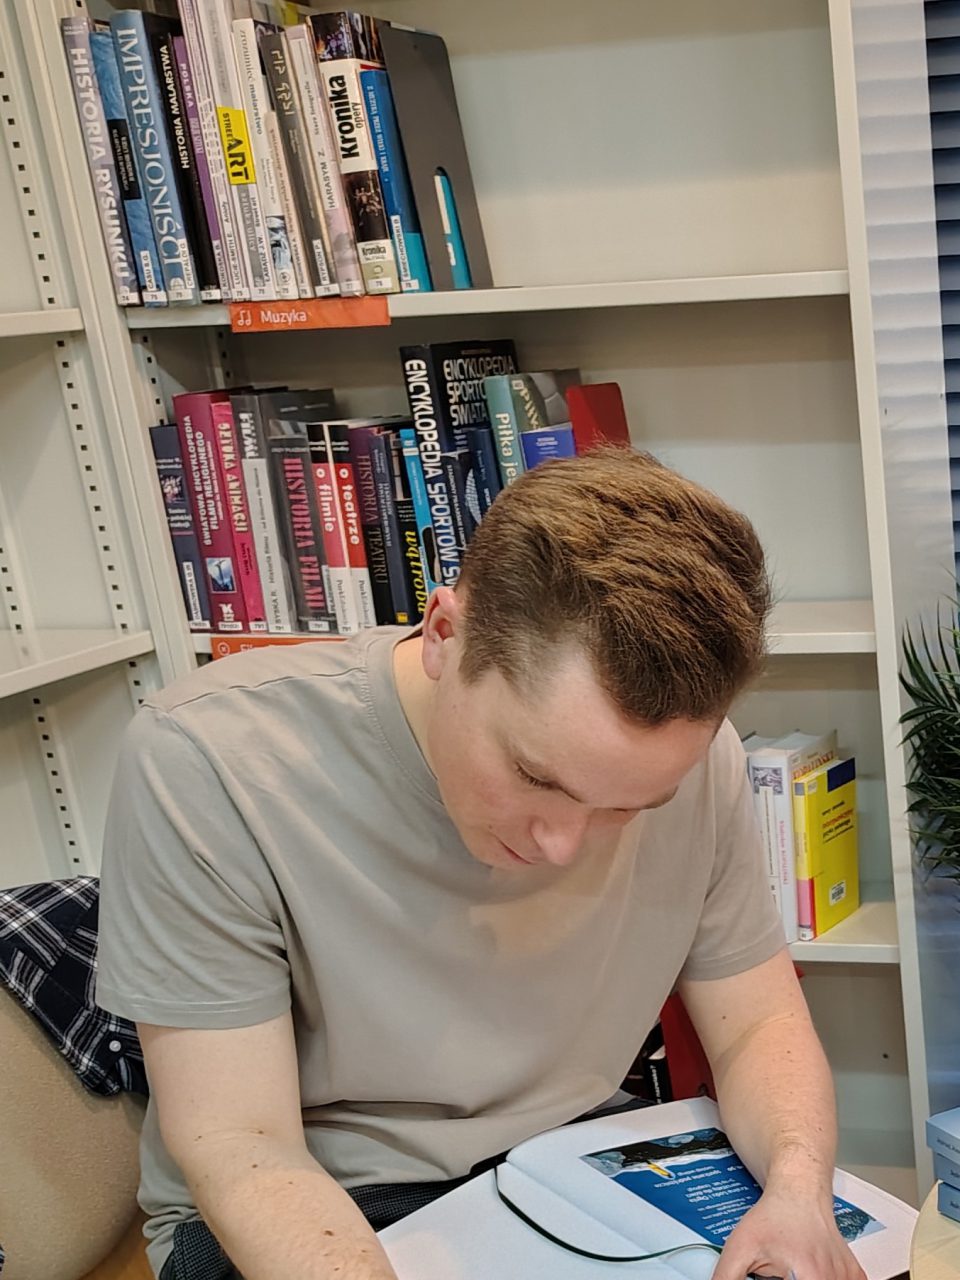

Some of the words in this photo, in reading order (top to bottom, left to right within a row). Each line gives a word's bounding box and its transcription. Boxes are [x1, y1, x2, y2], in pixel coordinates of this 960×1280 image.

[159, 45, 180, 115] MALARSTWA
[180, 63, 194, 107] POLSKA
[222, 113, 234, 142] STREET
[249, 82, 262, 135] malarstwo
[351, 102, 363, 129] opery
[70, 48, 106, 160] HISTORIA
[95, 168, 130, 278] RYSUNKU
[116, 28, 183, 265] IMPRESJONIŚCI
[171, 117, 190, 169] HISTORIA
[226, 136, 249, 181] ART
[321, 161, 335, 209] HARASYM
[261, 309, 307, 324] Muzyka
[443, 355, 516, 381] ENCYKLOPEDIA
[404, 359, 444, 479] ENCYKLOPEDIA
[495, 413, 515, 456] Piłka
[183, 415, 202, 492] ENCYKLOPEDIA
[195, 431, 213, 495] RELIGIJNEGO
[218, 423, 236, 471] SZTUKA
[316, 467, 326, 478] o
[339, 467, 349, 479] o
[197, 494, 212, 546] ŚWIATOWA
[205, 495, 219, 530] FILMU
[226, 473, 248, 532] ANIMACJI
[283, 458, 315, 548] HISTORIA
[318, 484, 336, 532] filmie
[342, 484, 360, 545] teatrze
[357, 455, 379, 523] HISTORIA
[368, 527, 388, 584] TEATRU
